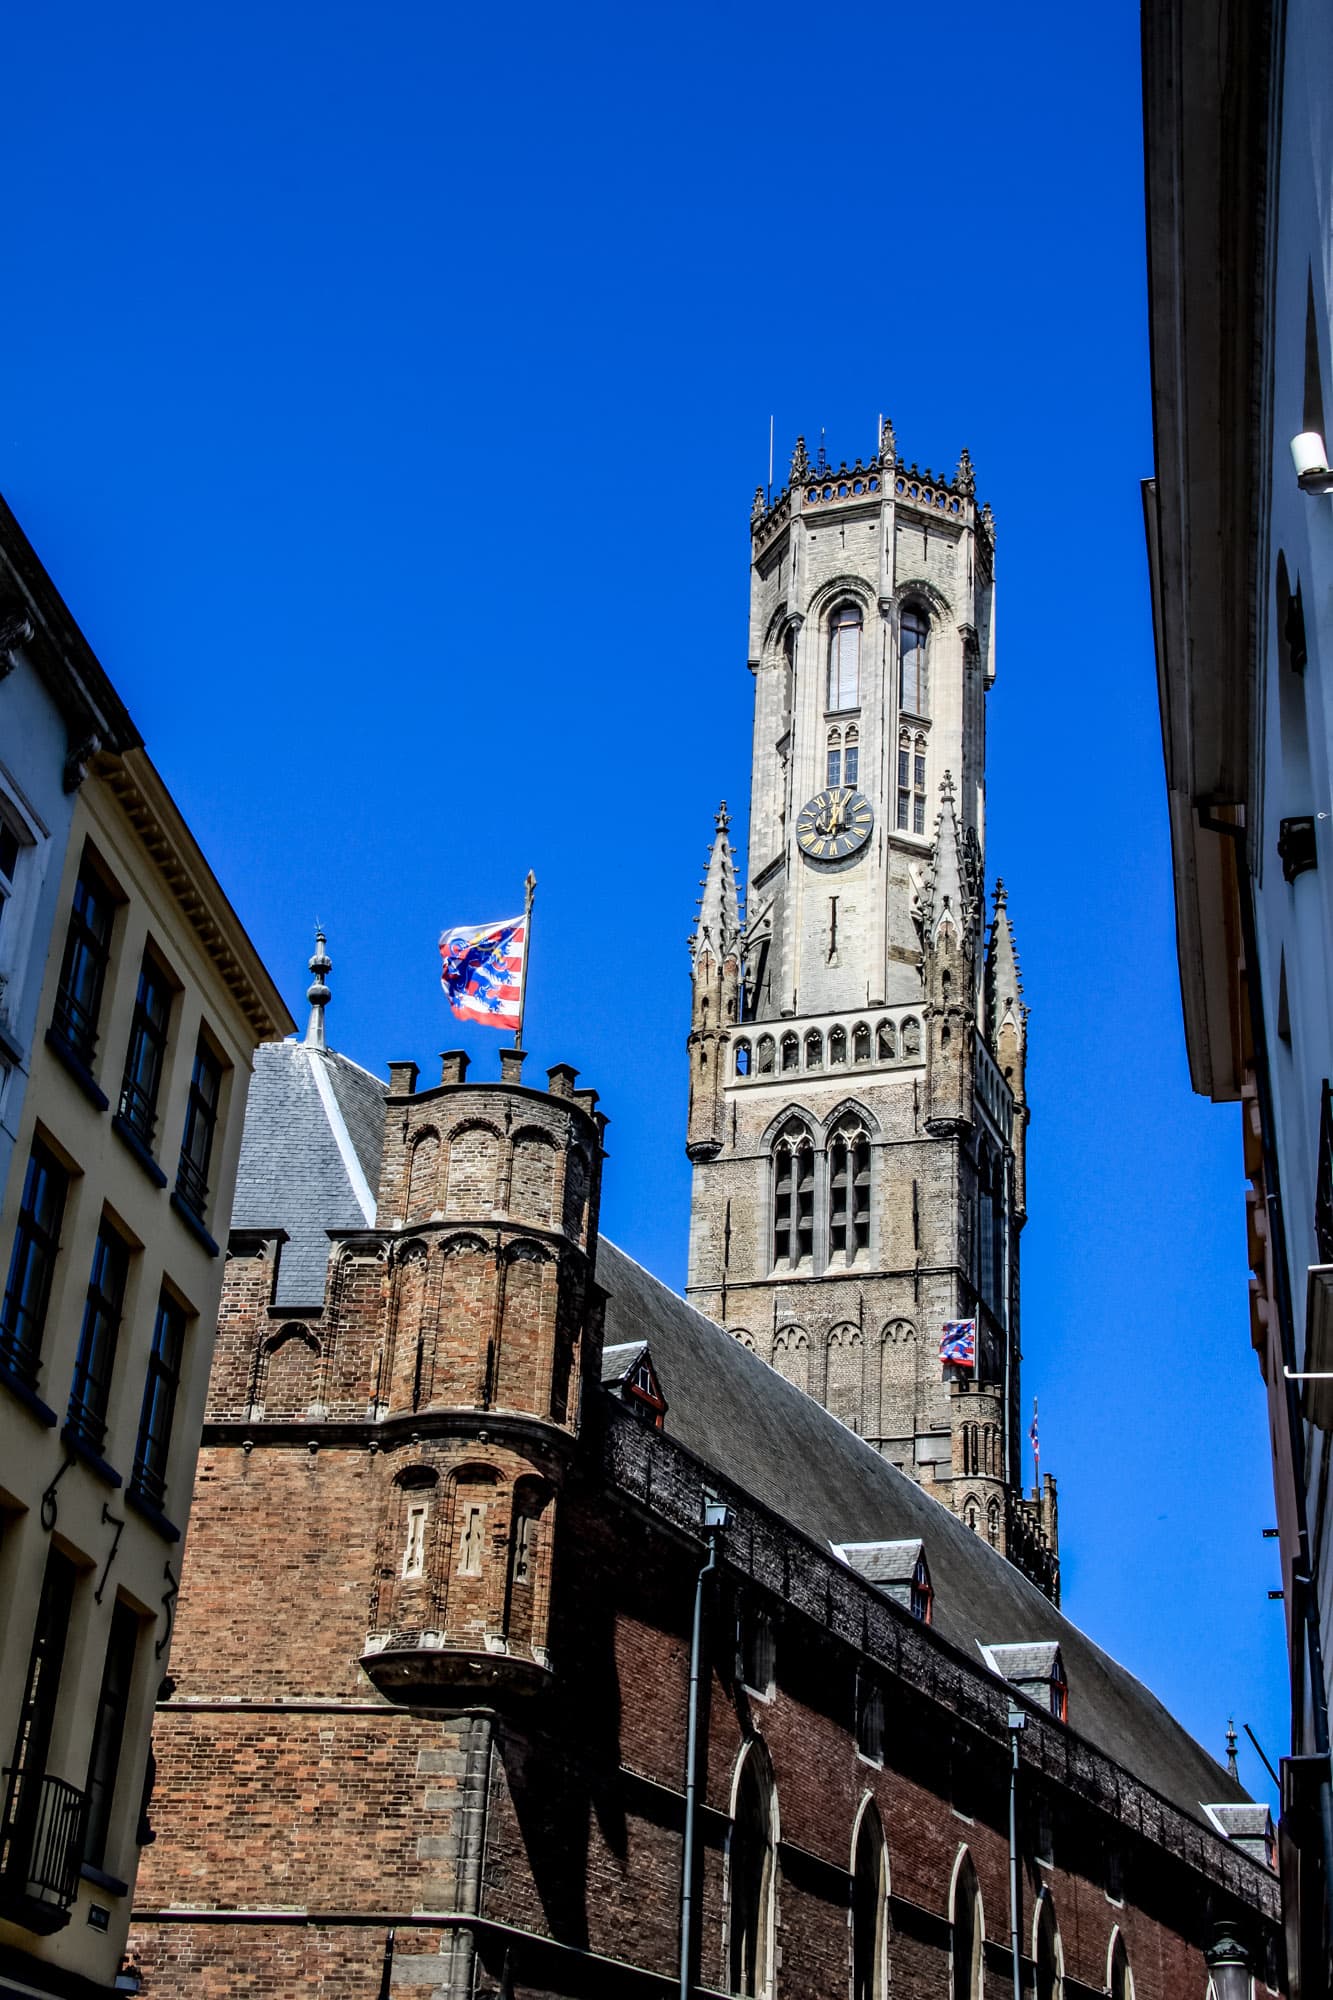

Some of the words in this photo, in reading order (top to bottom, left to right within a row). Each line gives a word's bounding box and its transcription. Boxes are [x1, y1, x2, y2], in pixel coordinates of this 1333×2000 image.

[813, 795, 826, 809] XI
[828, 790, 840, 803] XII
[852, 799, 867, 812] II
[802, 808, 816, 818] X
[855, 813, 872, 823] III
[798, 822, 813, 832] IX
[844, 837, 854, 849] V
